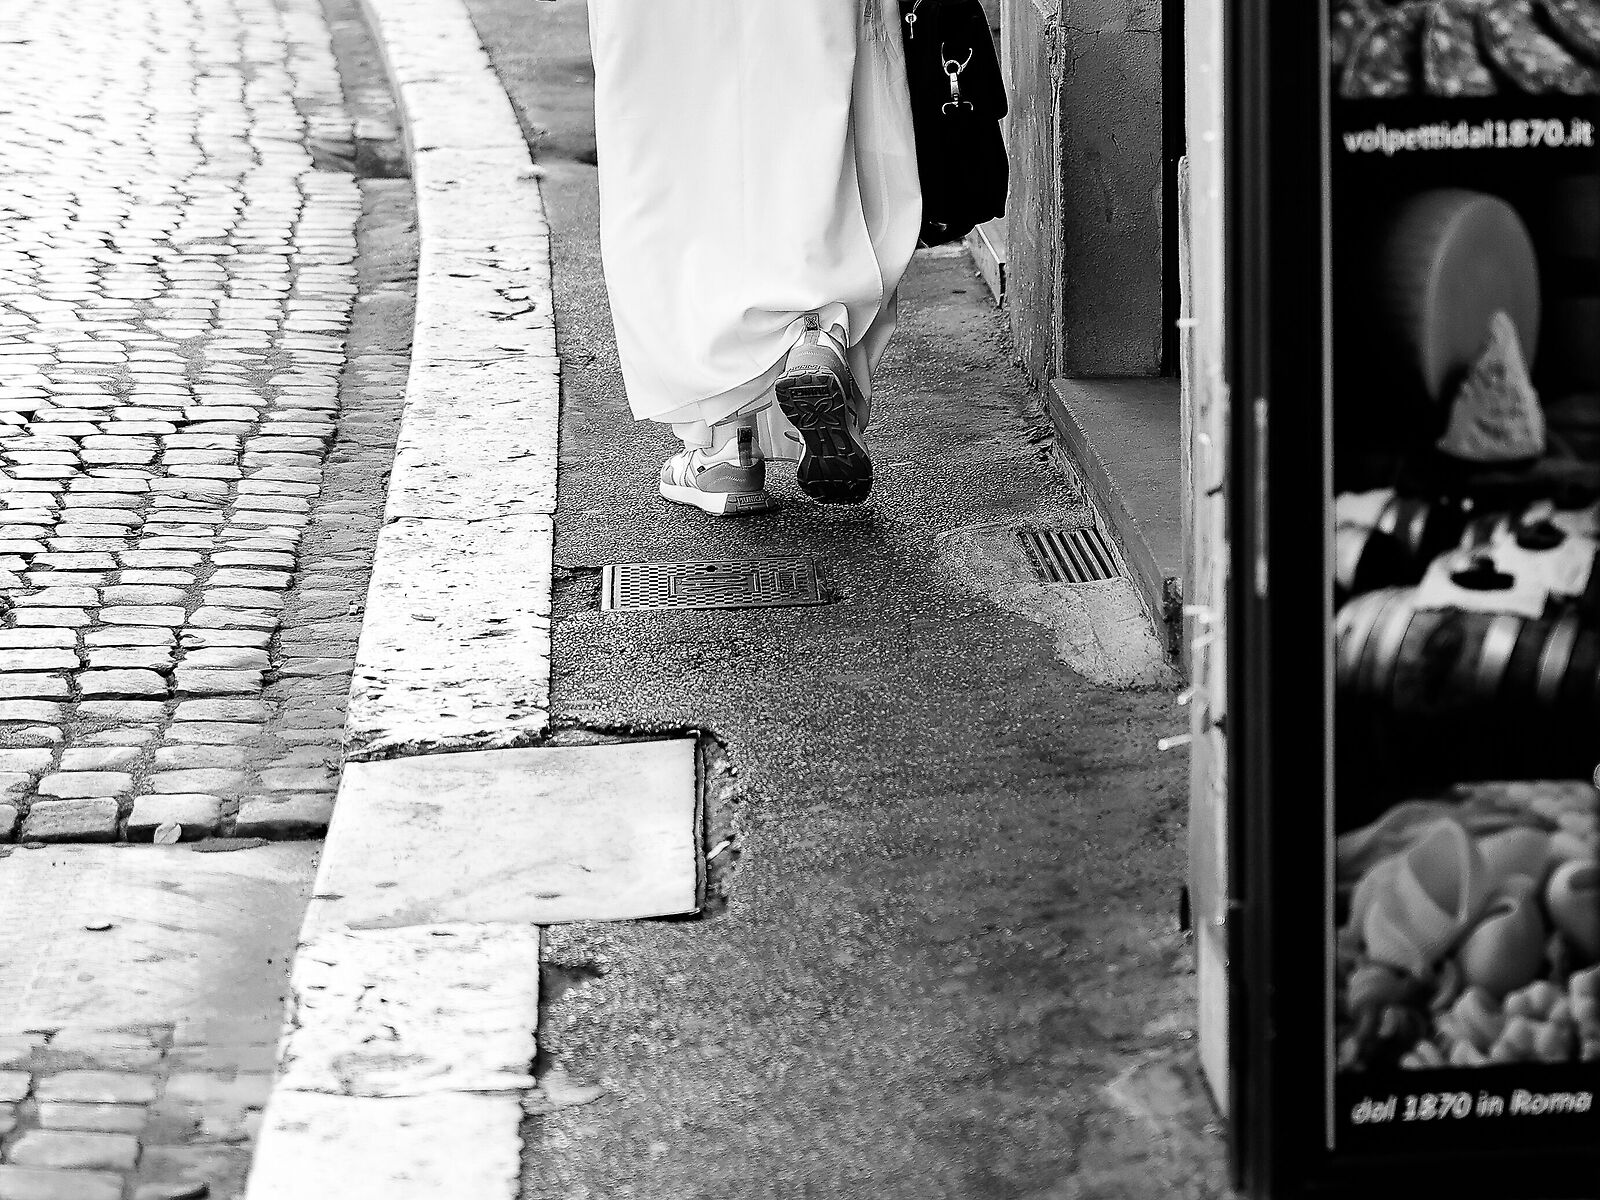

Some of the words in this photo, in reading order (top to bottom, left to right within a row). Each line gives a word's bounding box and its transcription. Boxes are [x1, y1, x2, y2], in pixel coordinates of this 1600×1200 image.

[1351, 1095, 1398, 1125] dal
[1401, 1090, 1473, 1122] 1870
[1475, 1088, 1505, 1118] in
[1509, 1088, 1593, 1116] Roma
